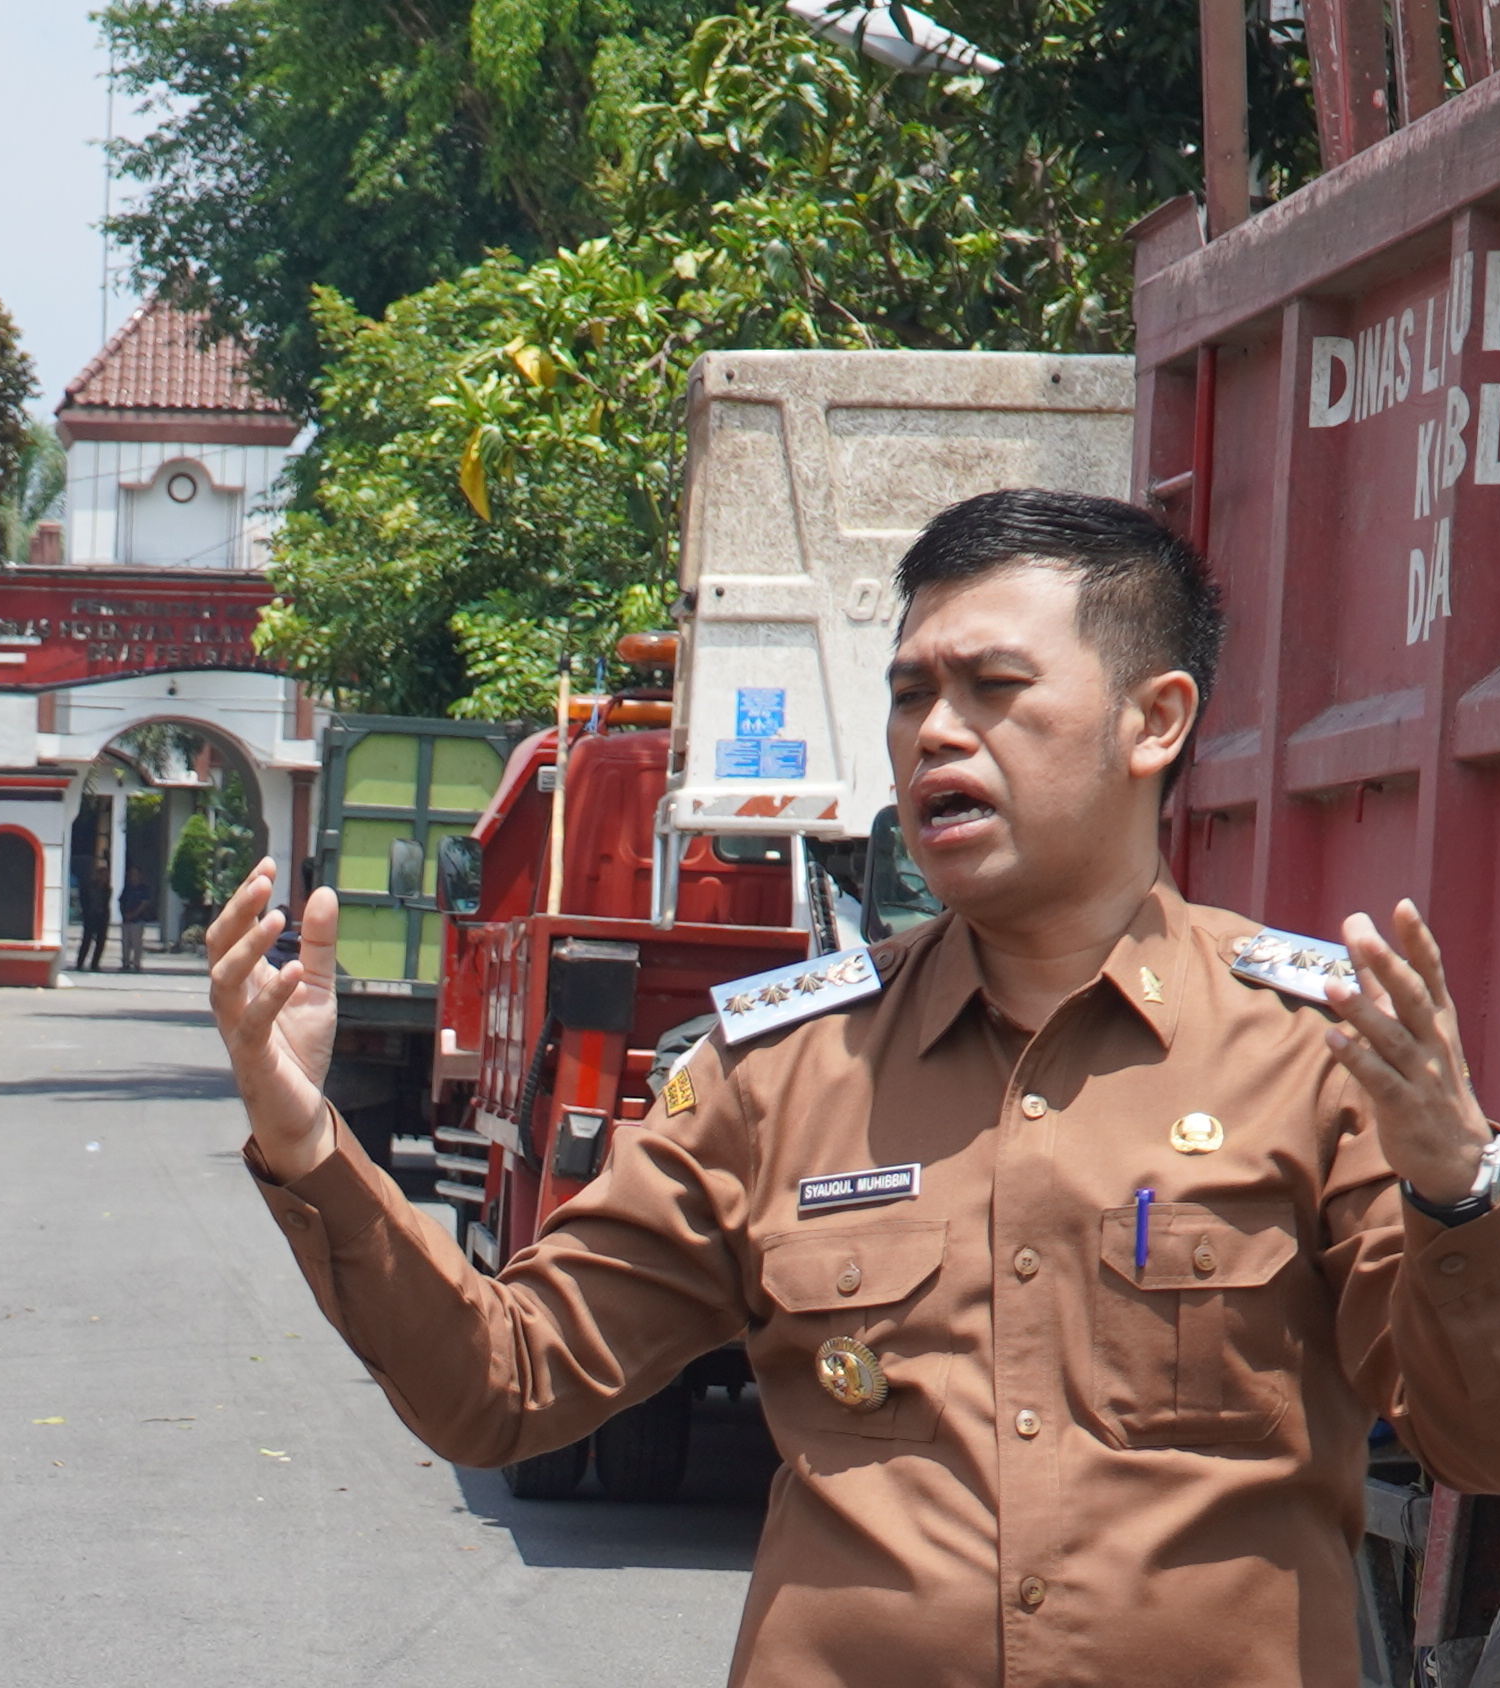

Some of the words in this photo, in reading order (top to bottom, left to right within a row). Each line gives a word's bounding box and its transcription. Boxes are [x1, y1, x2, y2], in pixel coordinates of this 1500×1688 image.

[1309, 307, 1414, 428] DINAS
[804, 1180, 854, 1199] SYAUQUL
[856, 1171, 912, 1192] MUHIBBIN
